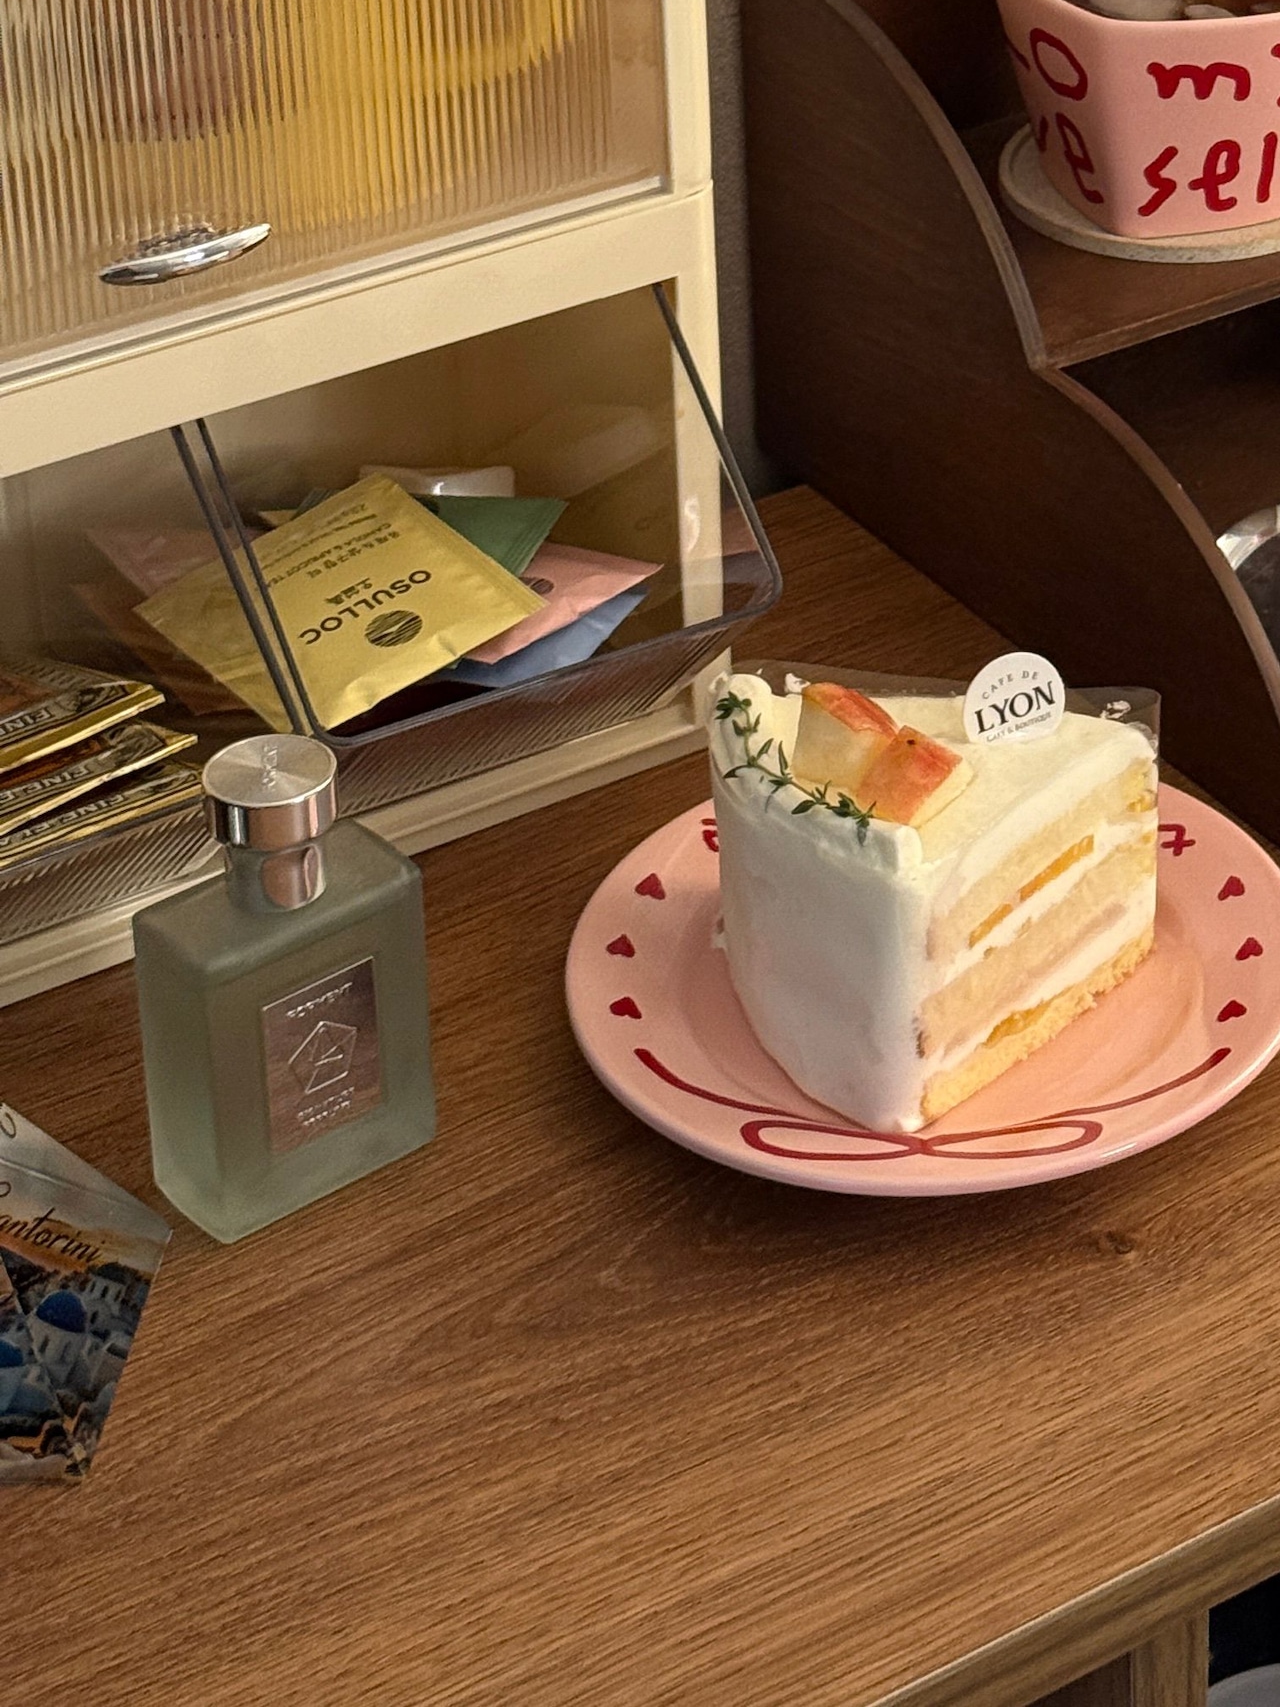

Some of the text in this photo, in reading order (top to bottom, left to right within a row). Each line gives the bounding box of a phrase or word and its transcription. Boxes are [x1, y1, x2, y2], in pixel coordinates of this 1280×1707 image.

[299, 569, 432, 645] OSULLOC
[982, 670, 1040, 700] CAFE DE
[974, 680, 1056, 735] LYON
[19, 765, 91, 791] FINE
[60, 793, 127, 823] FINE
